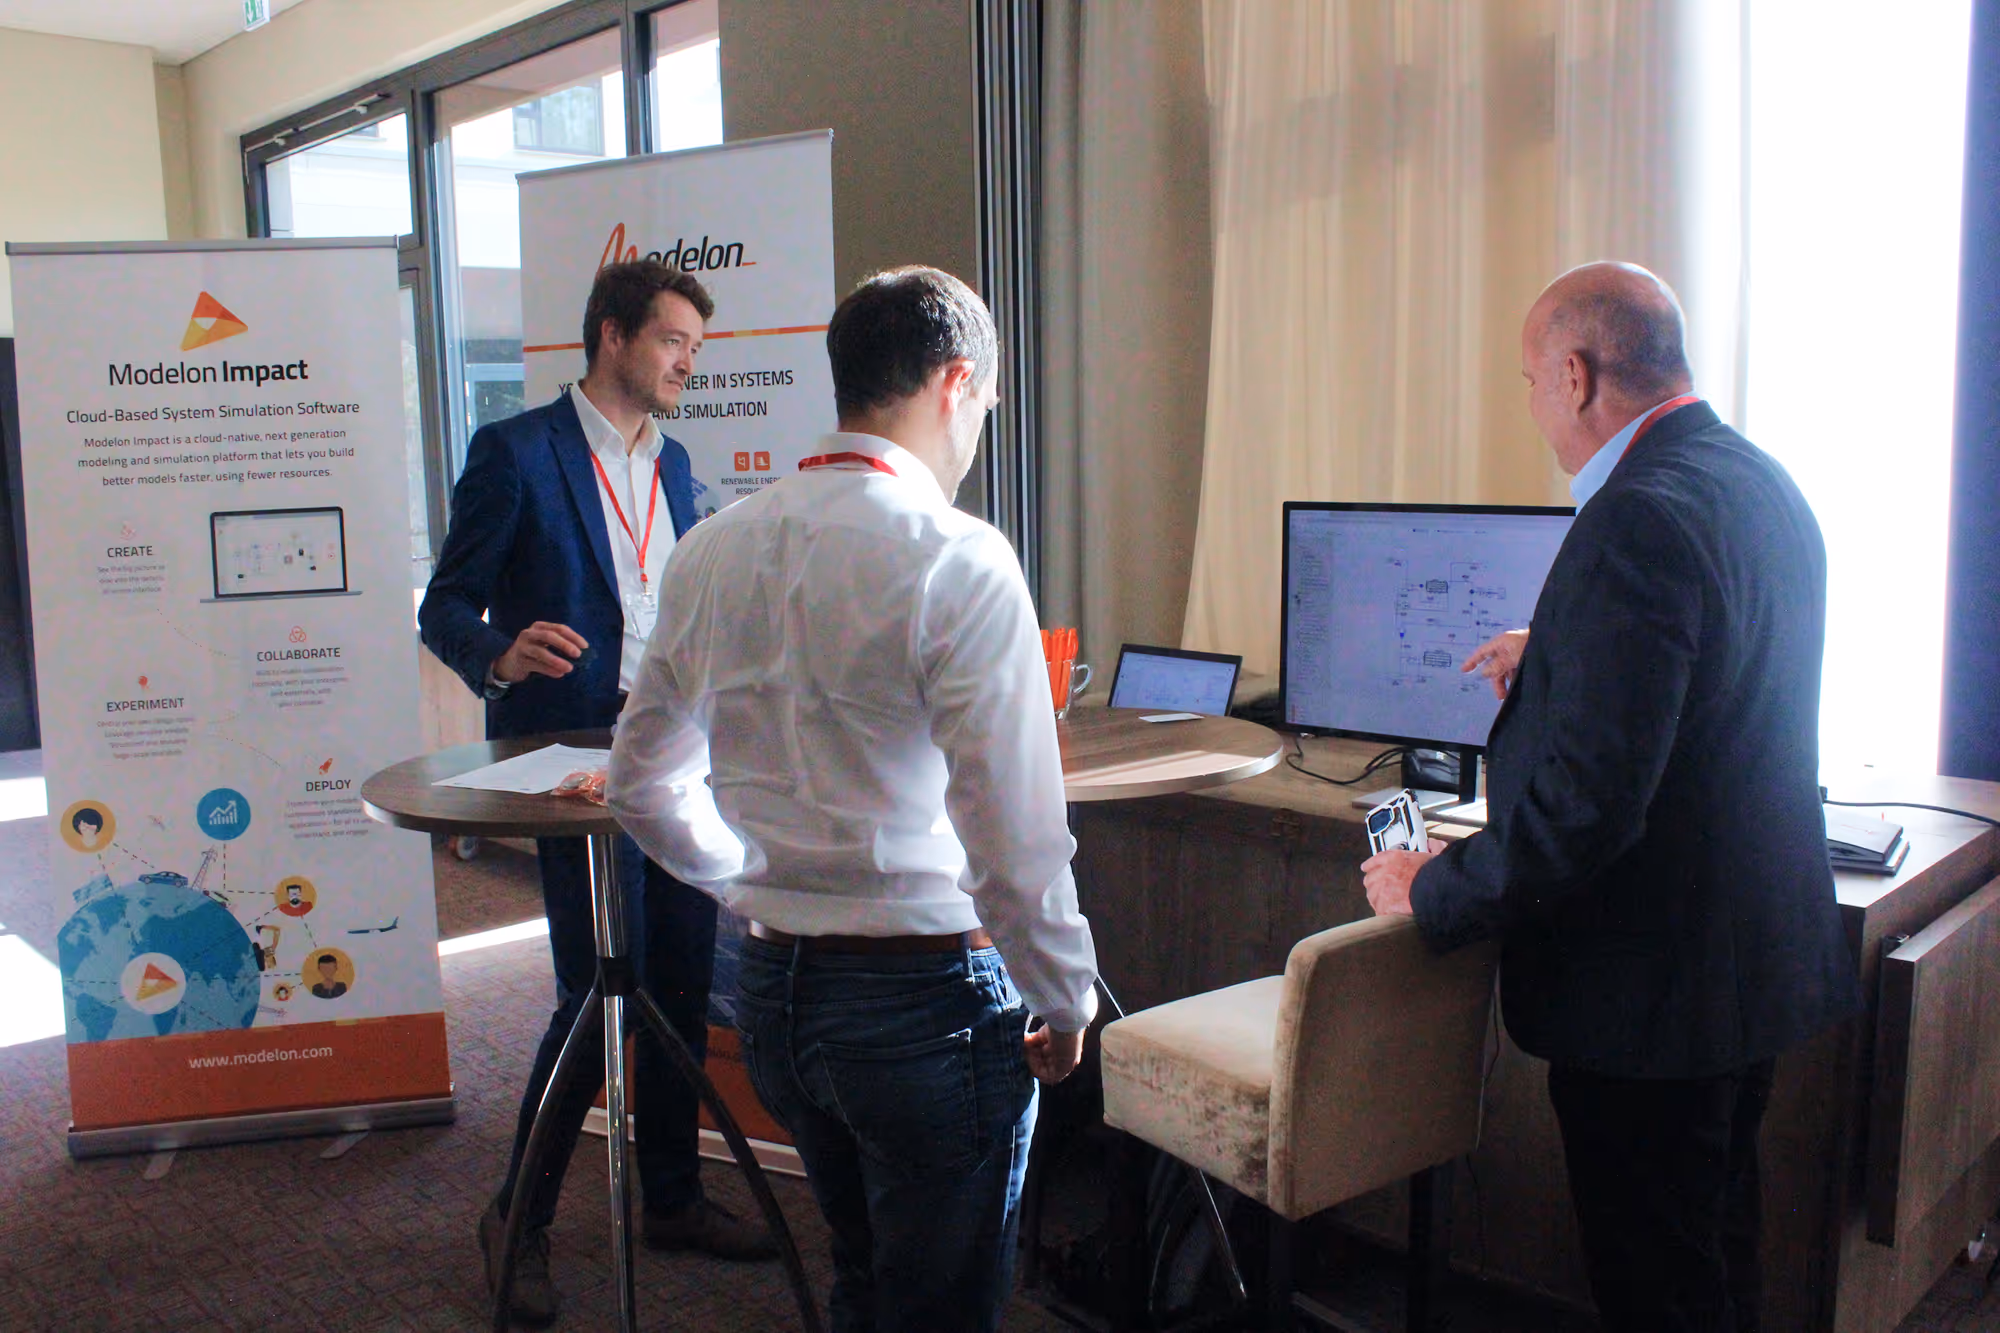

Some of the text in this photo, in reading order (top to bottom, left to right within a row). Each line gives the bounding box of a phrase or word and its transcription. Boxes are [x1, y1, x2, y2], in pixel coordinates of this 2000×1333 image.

[109, 359, 309, 387] Modelon Impact
[682, 370, 794, 390] NER IN SYSTEMS
[67, 401, 360, 423] Cloud-Based System Simulation Software
[684, 401, 768, 419] SIMULATION
[84, 437, 130, 448] Modelon
[133, 436, 170, 447] Impact
[173, 435, 182, 444] is
[185, 436, 191, 444] a
[265, 431, 288, 441] next
[290, 429, 346, 442] generation
[78, 447, 354, 468] modeling and simulation platform that lets you build
[102, 476, 134, 486] better
[137, 474, 176, 484] models
[216, 472, 244, 482] using
[247, 470, 276, 480] fewer
[721, 476, 782, 485] RENEWABLE ENER
[107, 546, 153, 558] CREATE
[257, 647, 341, 662] COLLABORATE
[107, 698, 184, 712] EXPERIMENT
[306, 779, 351, 792] DEPLOY
[188, 1046, 333, 1069] www.modelon.com
